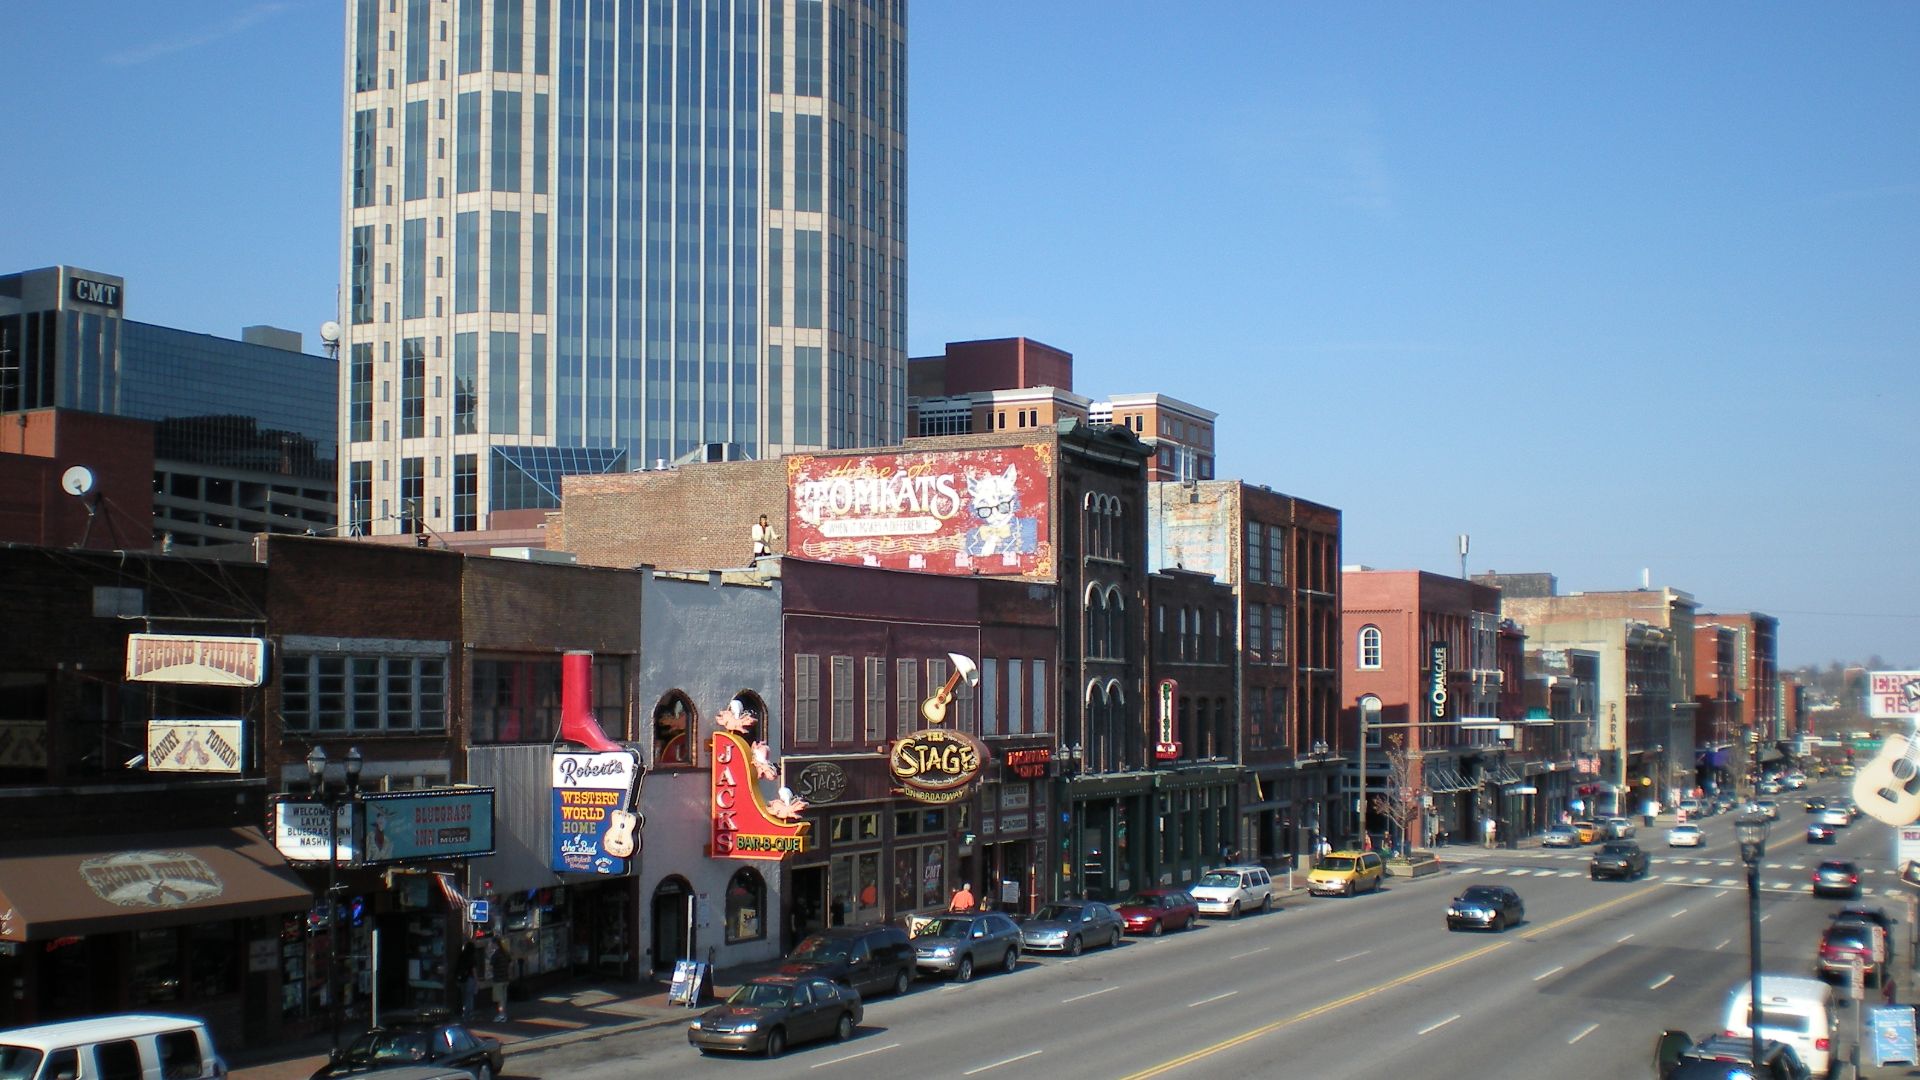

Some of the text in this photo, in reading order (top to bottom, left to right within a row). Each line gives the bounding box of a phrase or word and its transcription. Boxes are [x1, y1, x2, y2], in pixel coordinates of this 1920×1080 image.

[77, 280, 116, 305] CMT
[804, 469, 960, 526] TOMKATS
[134, 638, 257, 683] SECOND FIDDLE
[926, 731, 945, 742] THE
[150, 728, 181, 767] HONKY
[896, 738, 978, 778] STAGE
[559, 757, 626, 787] Robert's
[799, 768, 844, 795] STAGE
[561, 790, 620, 806] WESTERN
[716, 743, 739, 854] JACKS
[905, 787, 965, 802] ON BROADWAY
[415, 803, 472, 825] BLUEGRASS
[561, 806, 606, 821] WORLD
[287, 827, 331, 837] BLUEGRAS
[562, 821, 597, 834] HOME
[300, 837, 343, 847] NASHVIE
[439, 836, 468, 844] MUSIC
[561, 839, 598, 853] Sho-Bud
[735, 836, 801, 852] BAR-B-QUE
